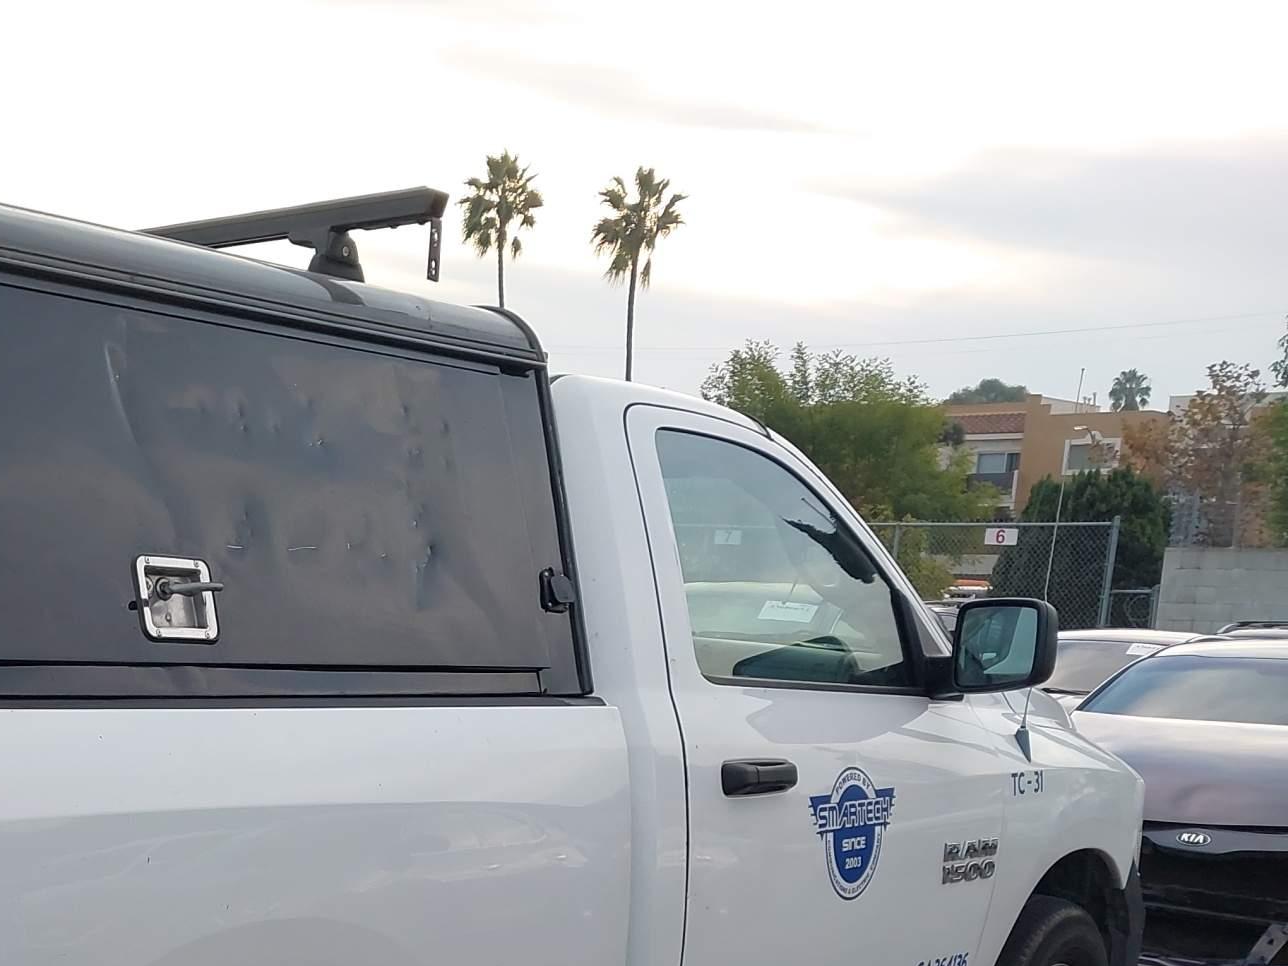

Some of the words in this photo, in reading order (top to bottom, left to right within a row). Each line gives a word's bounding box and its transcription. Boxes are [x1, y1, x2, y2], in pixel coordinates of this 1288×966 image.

[995, 529, 1005, 544] 6
[835, 773, 862, 794] POWERED
[817, 797, 891, 832] SMARTECH
[841, 837, 866, 852] SINCE
[1181, 833, 1204, 844] KIA
[943, 838, 999, 863] RAM
[845, 857, 863, 869] 2003
[942, 860, 996, 885] 1500
